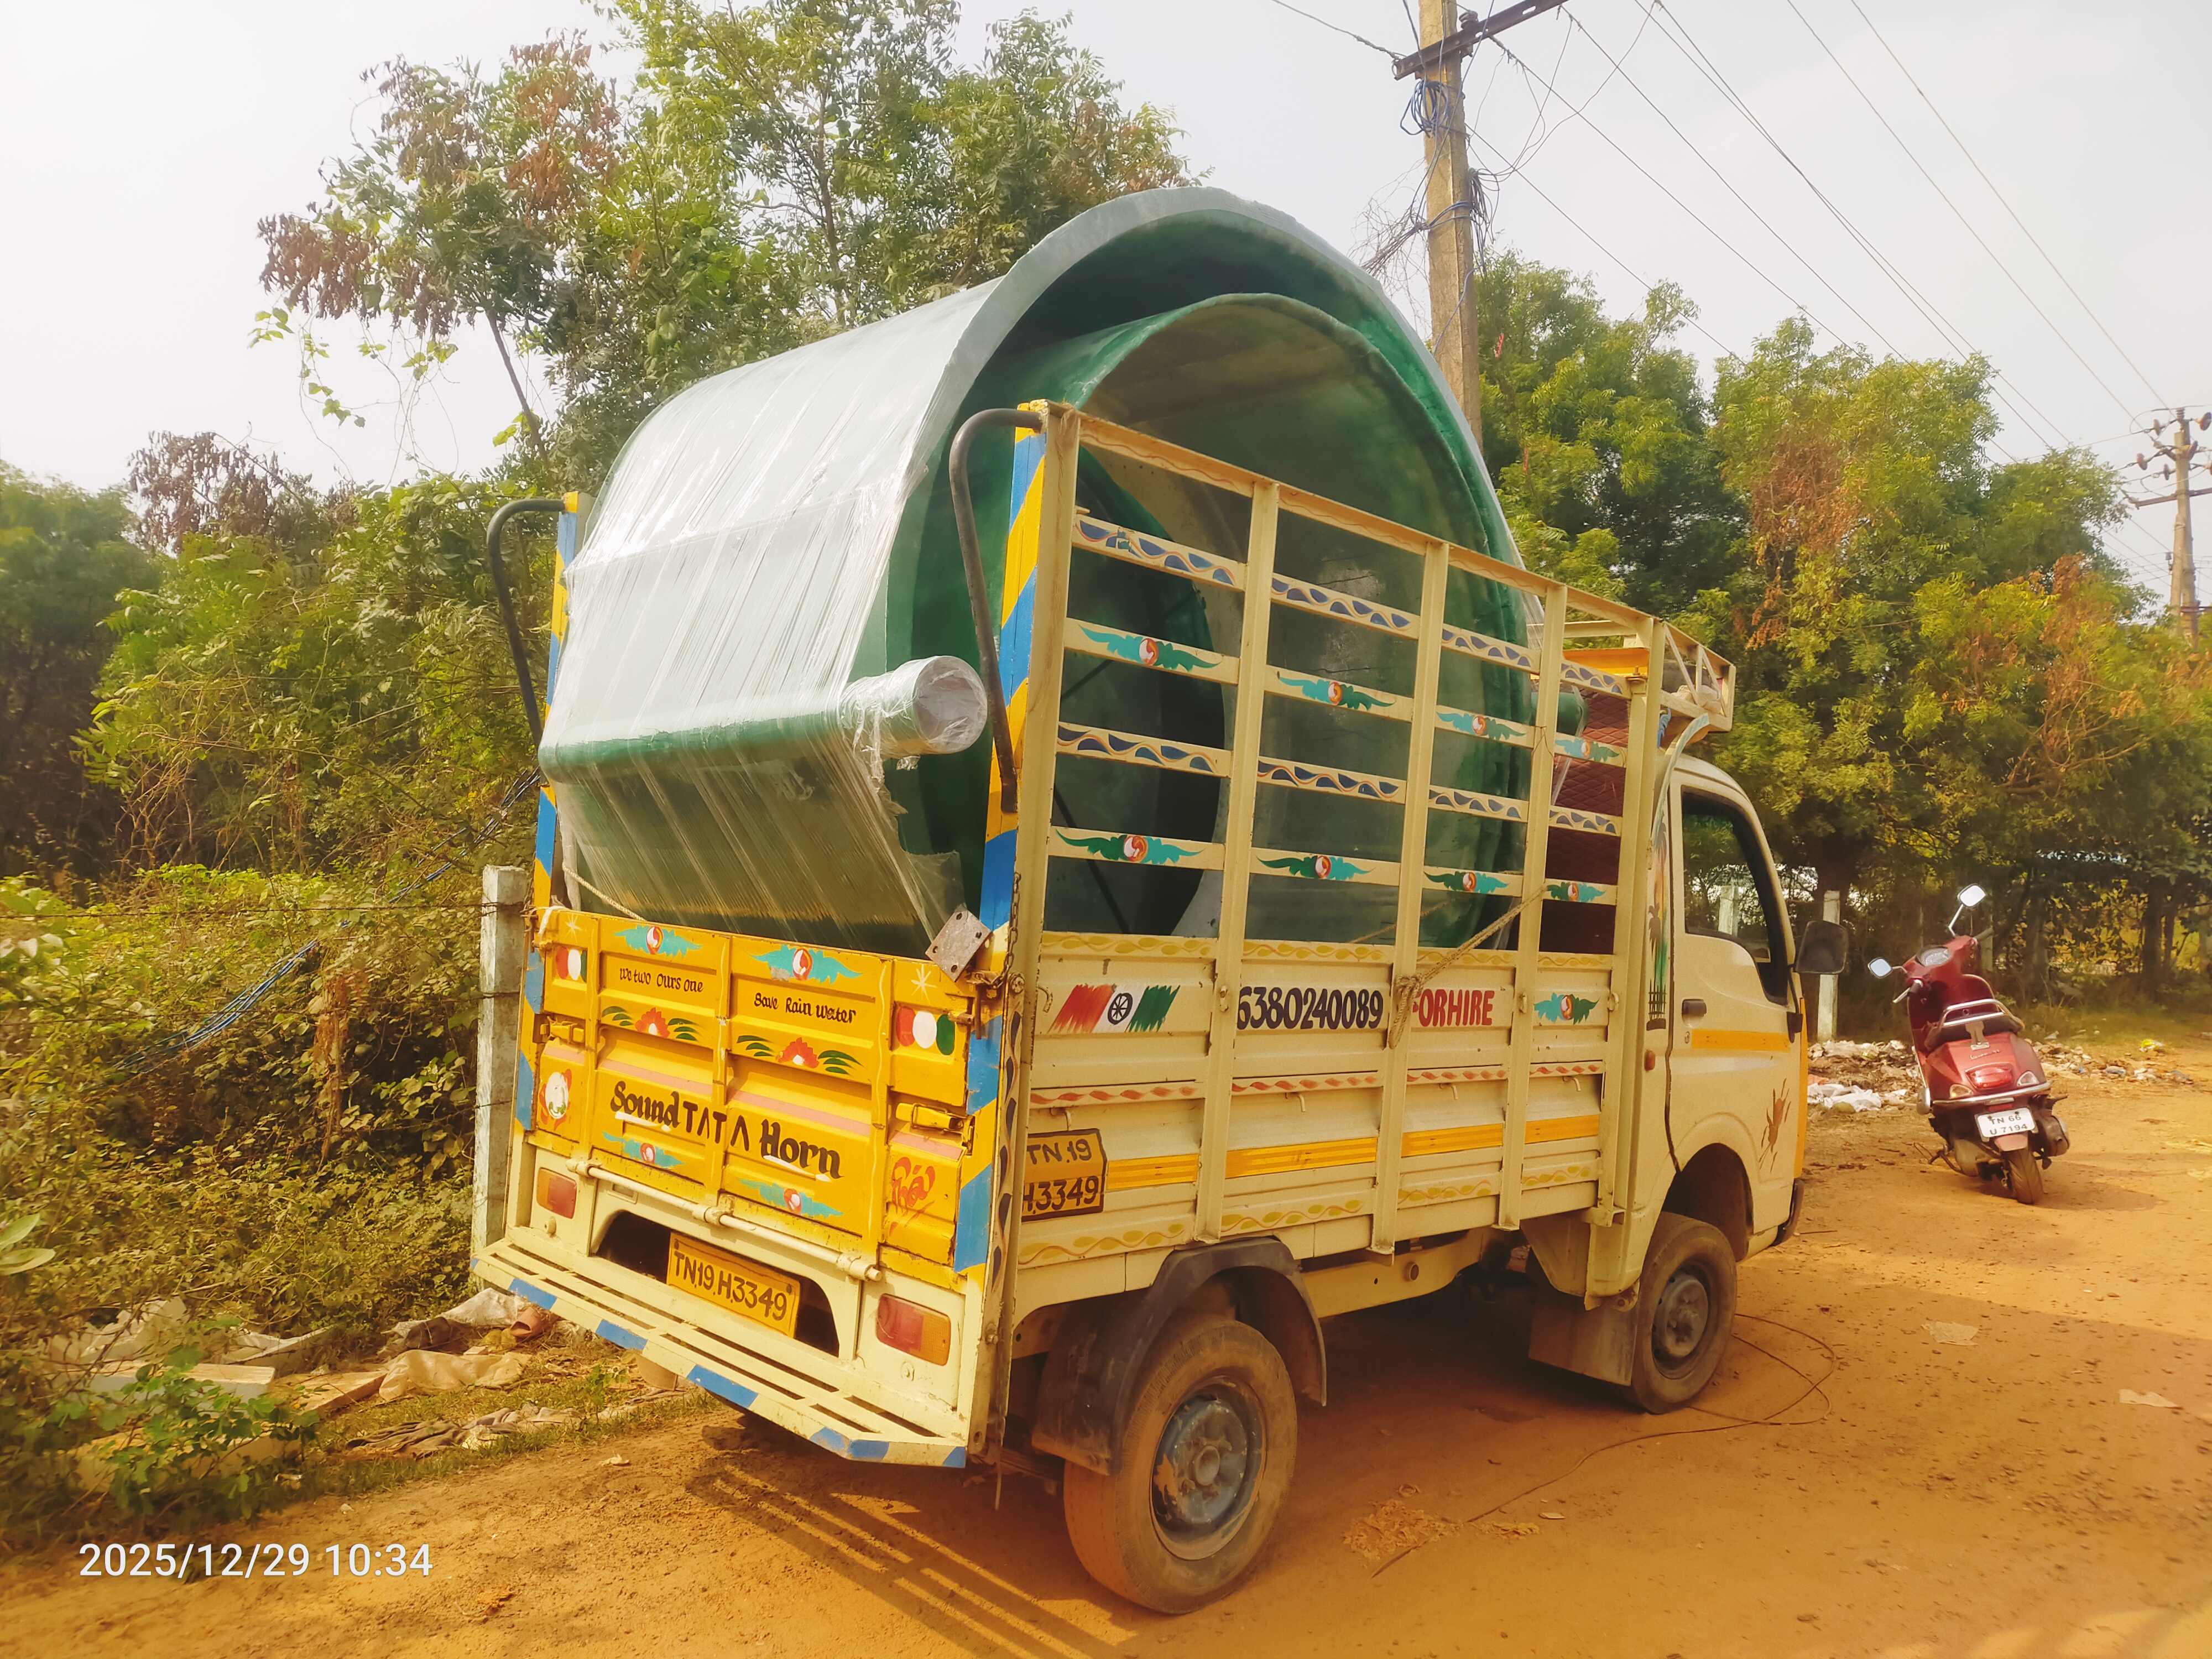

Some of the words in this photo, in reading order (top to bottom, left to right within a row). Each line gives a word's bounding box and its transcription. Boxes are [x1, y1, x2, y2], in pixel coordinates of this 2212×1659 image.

[634, 969, 651, 985] two
[754, 992, 779, 1010] Save
[785, 997, 814, 1016] Rain
[1237, 986, 1384, 1030] 6380240089
[610, 1081, 681, 1128] Sound
[683, 1100, 750, 1151] TATA
[759, 1119, 845, 1179] Horn
[2000, 1123, 2028, 1133] 7194
